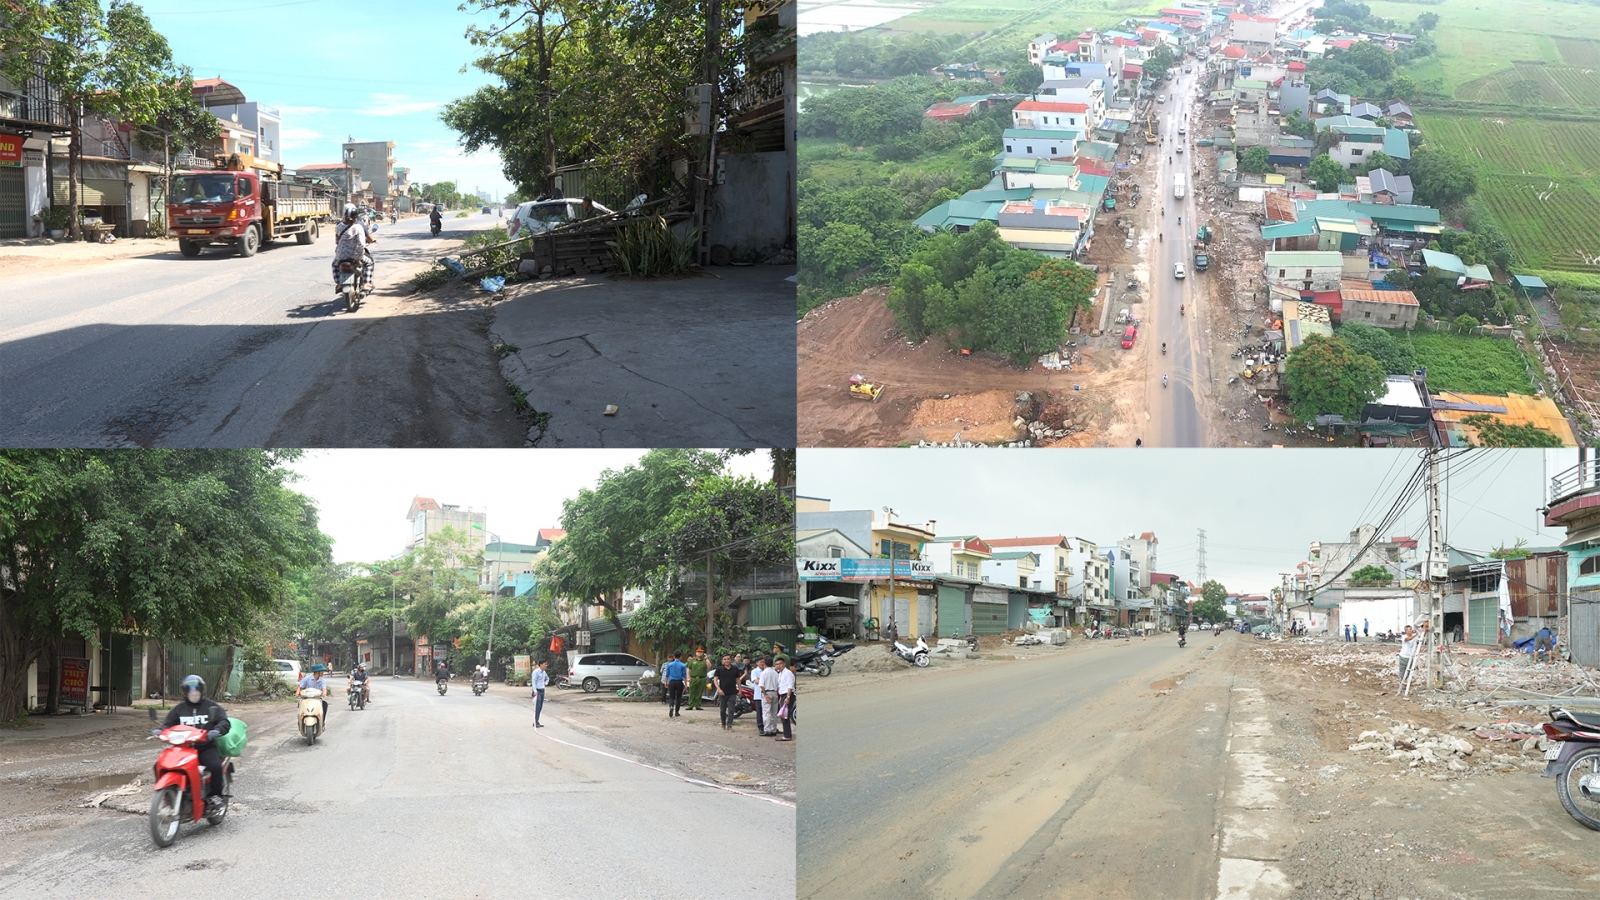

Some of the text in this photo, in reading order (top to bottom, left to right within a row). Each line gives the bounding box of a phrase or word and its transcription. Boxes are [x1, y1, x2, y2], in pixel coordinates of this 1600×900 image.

[804, 561, 837, 571] Kixx
[911, 562, 931, 572] Kixx
[64, 678, 84, 687] CHÓ
